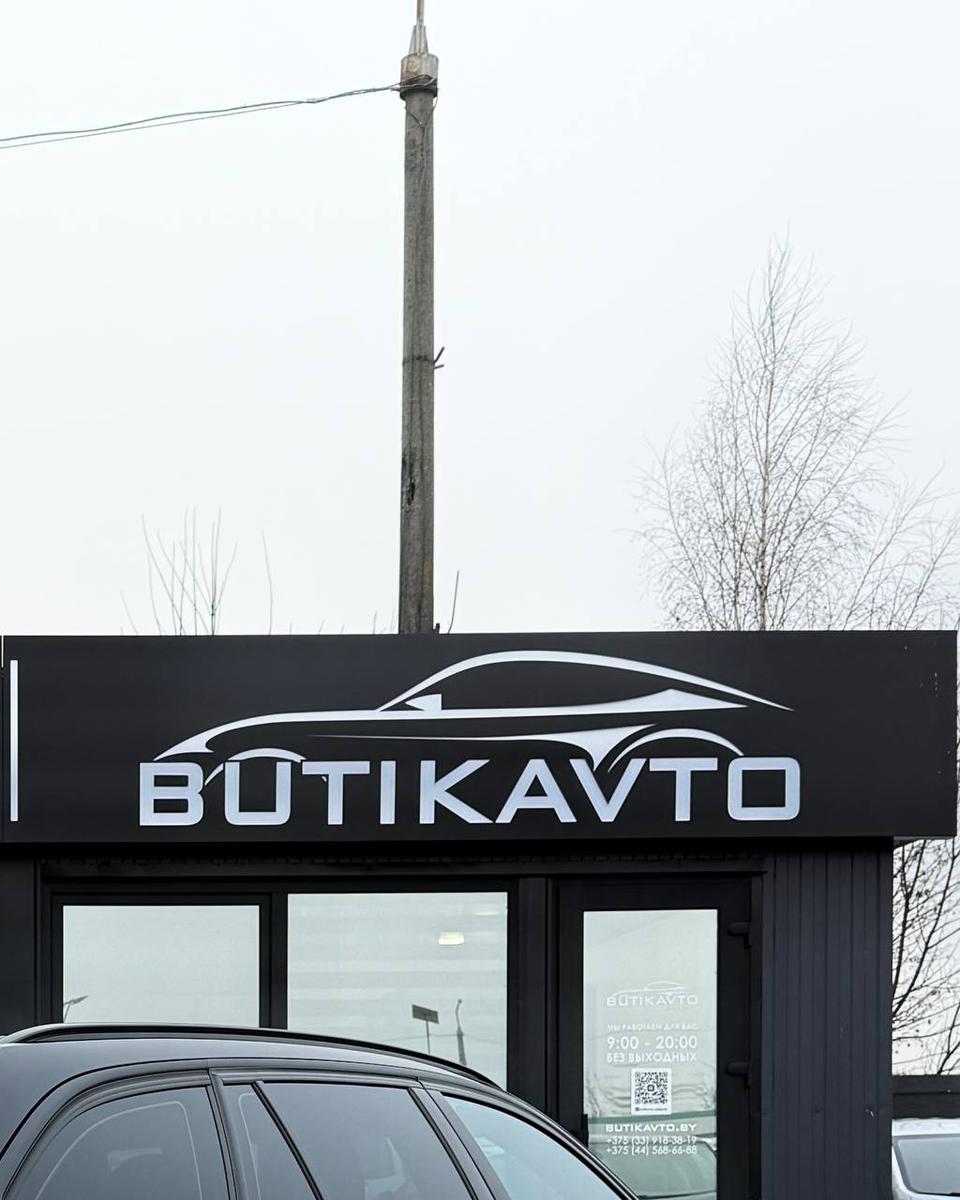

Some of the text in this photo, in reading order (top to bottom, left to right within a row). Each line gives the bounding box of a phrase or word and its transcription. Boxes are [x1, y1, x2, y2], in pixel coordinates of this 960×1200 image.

[139, 755, 801, 828] BUTIKAVTO
[606, 994, 698, 1006] BUTIKAVTO
[607, 1036, 639, 1049] 9:00
[656, 1035, 697, 1049] 20:00
[606, 1051, 697, 1063] БЕЗ ВЫХОДНЫХ
[606, 1123, 697, 1132] BUTIKAVTO.BY
[607, 1136, 697, 1146] +375 (33) 918-38-19
[607, 1146, 697, 1156] +375 (44) 568-66-88
